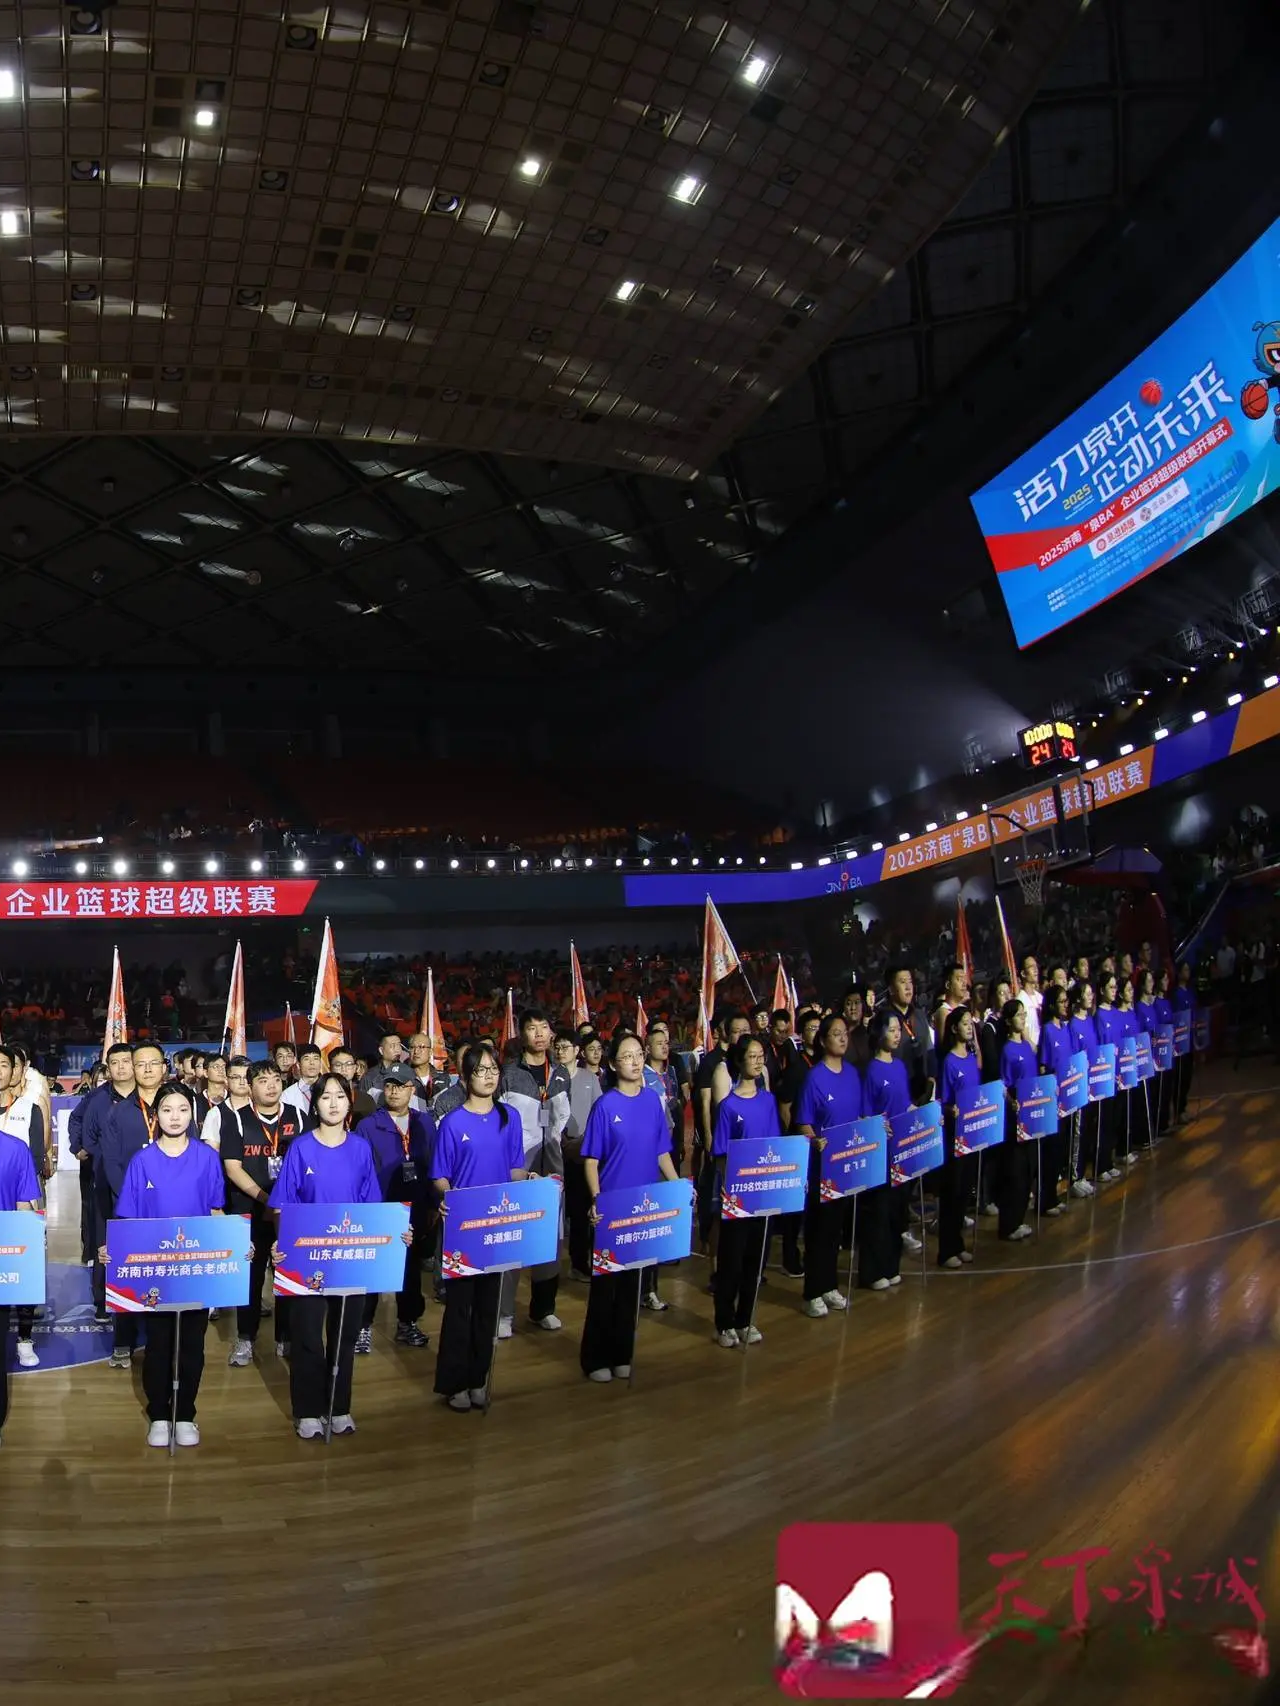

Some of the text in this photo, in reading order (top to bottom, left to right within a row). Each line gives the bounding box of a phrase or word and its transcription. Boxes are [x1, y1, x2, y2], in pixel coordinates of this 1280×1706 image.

[1092, 361, 1234, 504] 企动未来
[1013, 402, 1139, 522] 活力泉开
[1038, 531, 1082, 567] 2025济南
[1120, 423, 1228, 511] 企业篮球超级联赛开幕式
[1062, 483, 1093, 511] 2025
[1031, 742, 1051, 765] 24
[309, 1248, 376, 1261] 山东卓威集团
[116, 1262, 240, 1279] 济南市寿光商会老虎队
